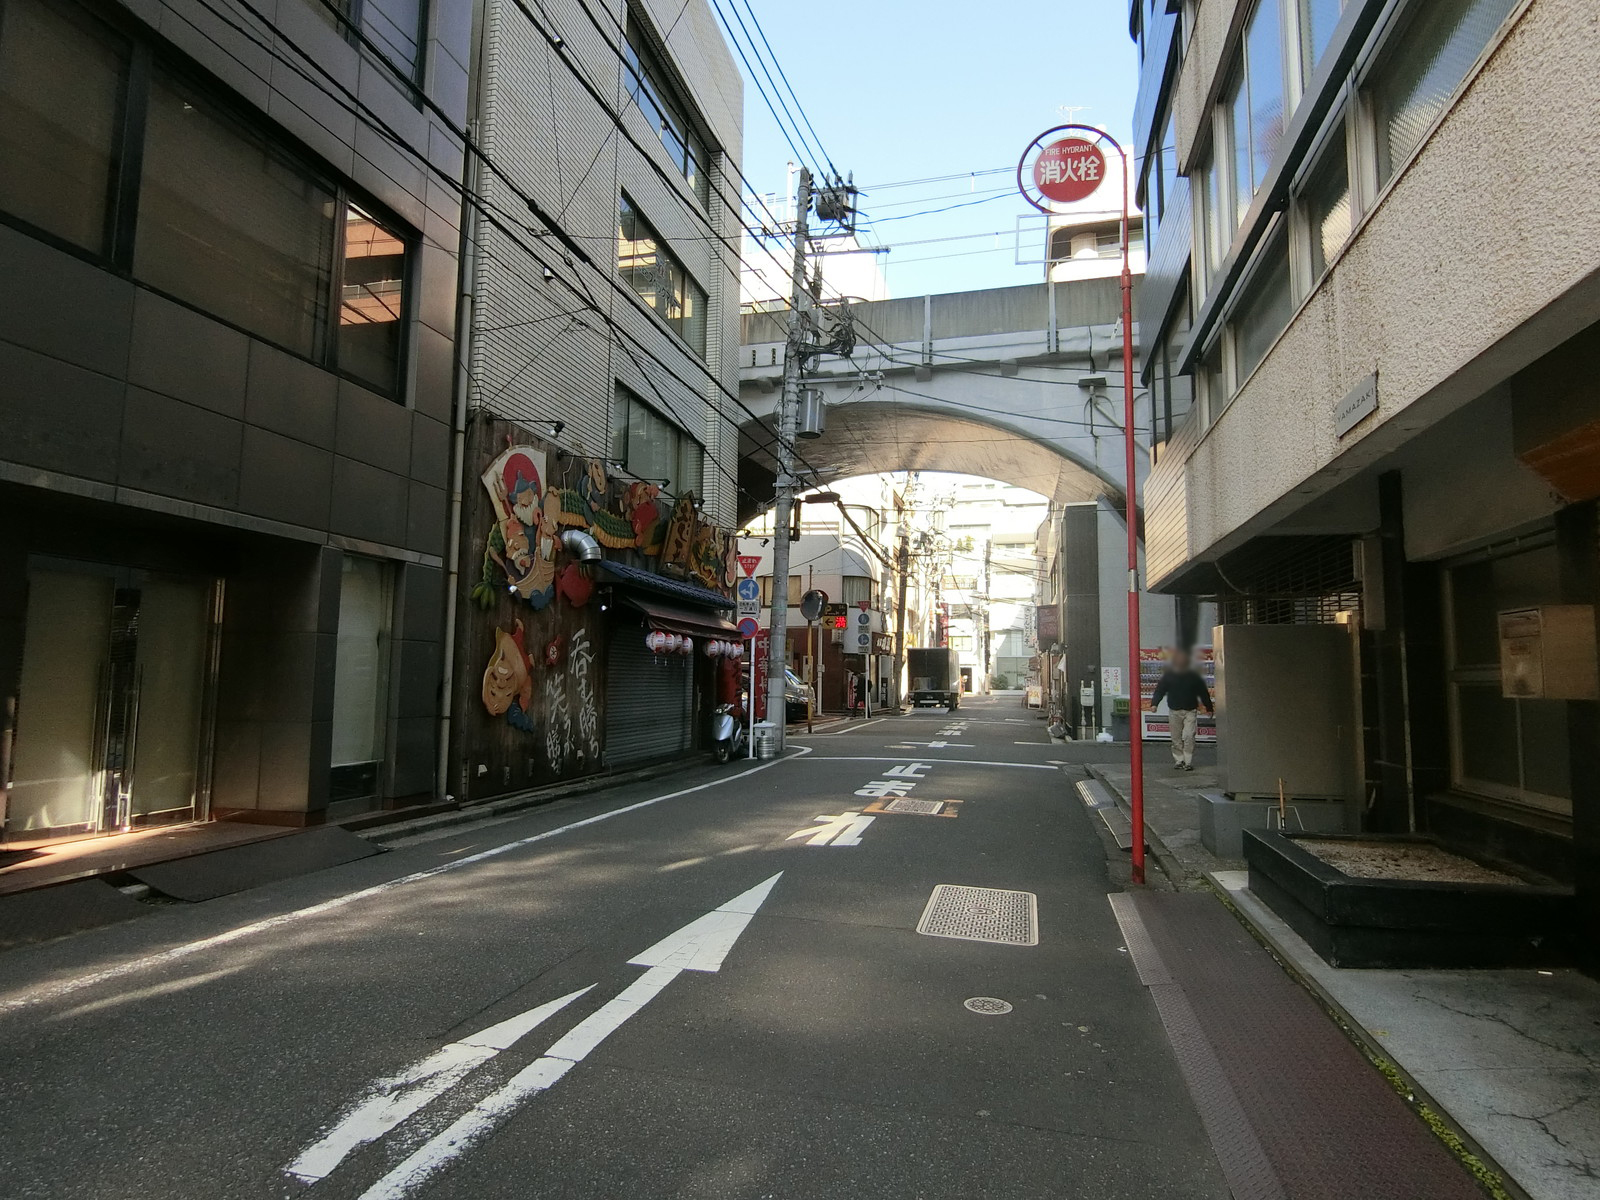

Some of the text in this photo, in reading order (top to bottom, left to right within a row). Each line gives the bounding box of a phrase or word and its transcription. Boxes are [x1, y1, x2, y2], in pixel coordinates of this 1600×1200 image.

[1045, 144, 1094, 156] FIRE HYDRANT
[1039, 155, 1101, 186] 消火栓
[1337, 387, 1374, 422] YAMAZAKI
[835, 616, 847, 628] 満
[785, 762, 932, 846] 止まれ
